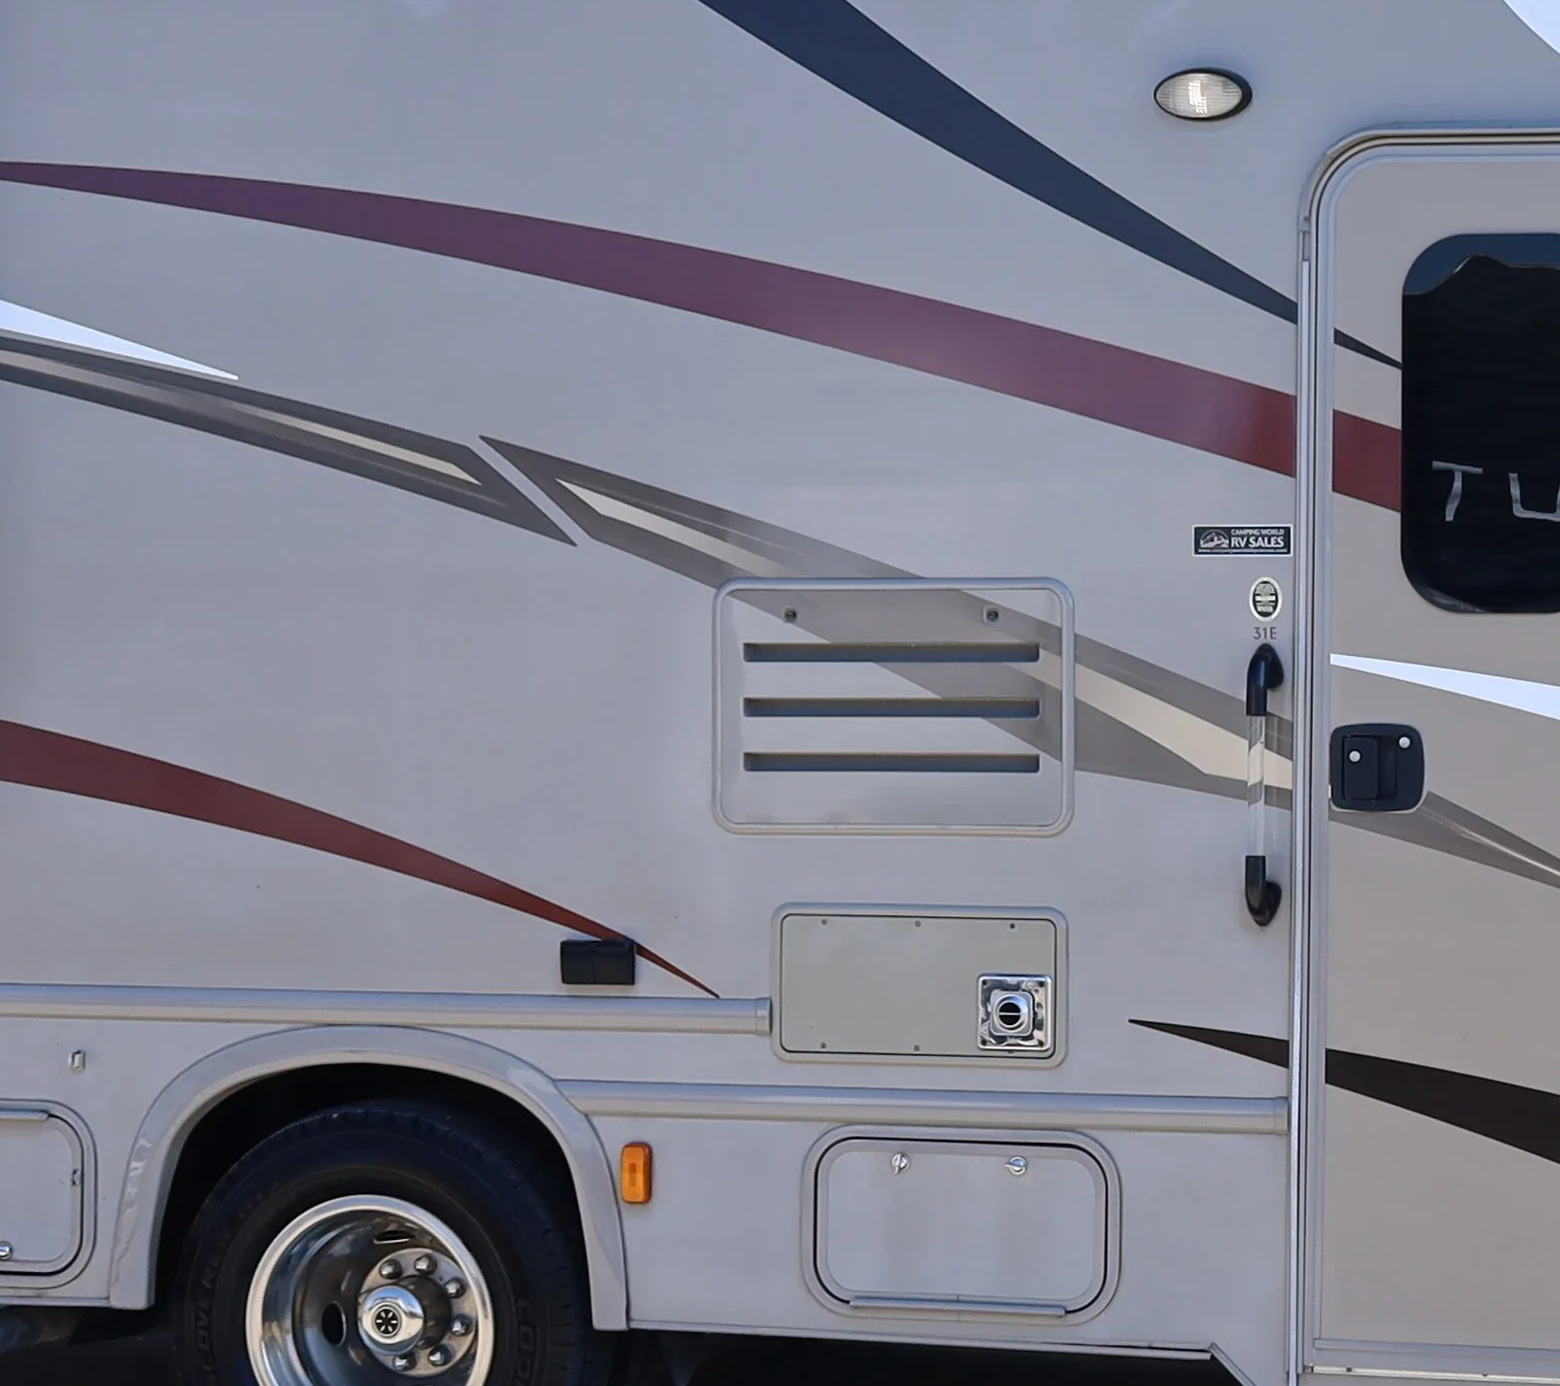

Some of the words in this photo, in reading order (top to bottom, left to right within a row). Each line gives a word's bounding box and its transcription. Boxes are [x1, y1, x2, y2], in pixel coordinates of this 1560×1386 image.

[1230, 536, 1247, 548] RV
[1248, 536, 1285, 548] SALES
[1253, 626, 1278, 640] 31E
